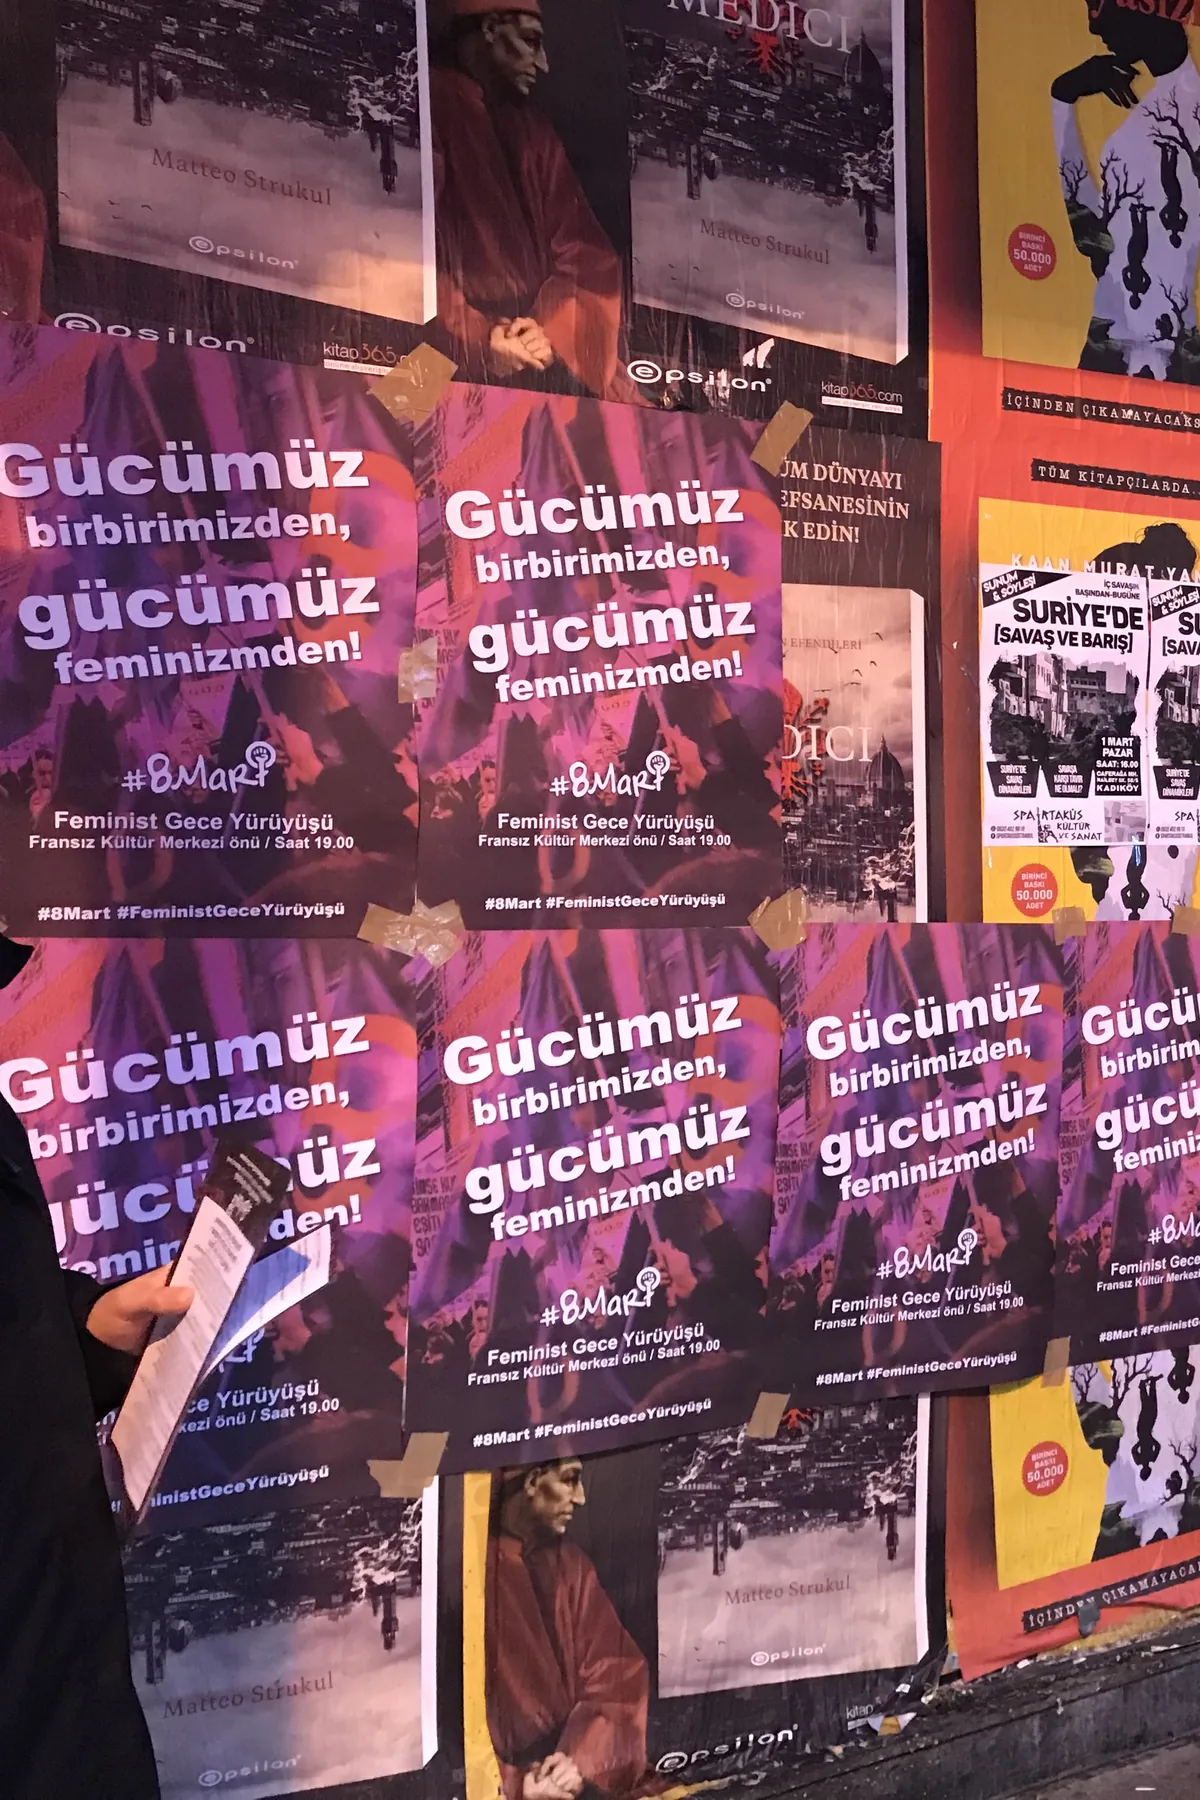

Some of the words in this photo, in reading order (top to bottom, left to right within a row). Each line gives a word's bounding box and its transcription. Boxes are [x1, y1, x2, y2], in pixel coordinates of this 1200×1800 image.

[151, 147, 237, 184] Matteo
[245, 171, 332, 206] Strukul
[699, 218, 761, 249] Matteo
[765, 235, 830, 266] Strukul
[1013, 249, 1051, 266] 50.000
[1006, 392, 1076, 415] İÇİNDEN
[0, 438, 370, 498] Gücümüz
[813, 461, 902, 490] DÜNYAYI
[1038, 464, 1071, 482] TÜM
[26, 506, 351, 549] birbirimizden,
[445, 480, 744, 540] Gücümüz
[476, 543, 730, 583] birbirimizden,
[17, 566, 380, 651] gücümüz
[1012, 596, 1144, 630] SURİYE'DE
[54, 630, 364, 685] feminizmden!
[468, 593, 756, 674] gücümüz
[1057, 631, 1079, 646] VE
[495, 650, 743, 703] feminizmden!
[1102, 748, 1133, 758] PAZAR
[1107, 737, 1134, 747] MART
[1096, 783, 1139, 792] KADIKÖY
[54, 811, 158, 831] Feminist
[164, 811, 223, 831] Gece
[229, 811, 335, 835] Yürüyüşü
[478, 832, 531, 847] Fransız
[534, 832, 576, 847] Kültür
[579, 832, 630, 847] Merkezi
[633, 833, 658, 848] önü
[668, 833, 697, 847] Saat
[699, 832, 732, 847] 19.00
[497, 812, 578, 830] Feminist
[583, 813, 629, 830] Gece
[633, 812, 715, 833] Yürüyüşü
[37, 905, 111, 922] #8Mart
[117, 902, 346, 921] #FeministGeceYürüyüşü
[1017, 889, 1053, 901] 50.000
[442, 991, 743, 1088] Gücümüz
[805, 980, 1043, 1063] Gücümüz
[0, 1011, 370, 1114] Gücümüz
[829, 1038, 1032, 1099] birbirimizden,
[472, 1053, 727, 1127] birbirimizden,
[28, 1078, 350, 1161] birbirimizden,
[819, 1080, 1048, 1177] gücümüz
[464, 1103, 751, 1214] gücümüz
[839, 1127, 1036, 1202] feminizmden!
[490, 1155, 736, 1242] feminizmden!
[724, 1585, 784, 1607] Matteo
[788, 1574, 852, 1598] Strukul
[163, 1690, 244, 1721] Matteo
[251, 1670, 334, 1703] Strukul
